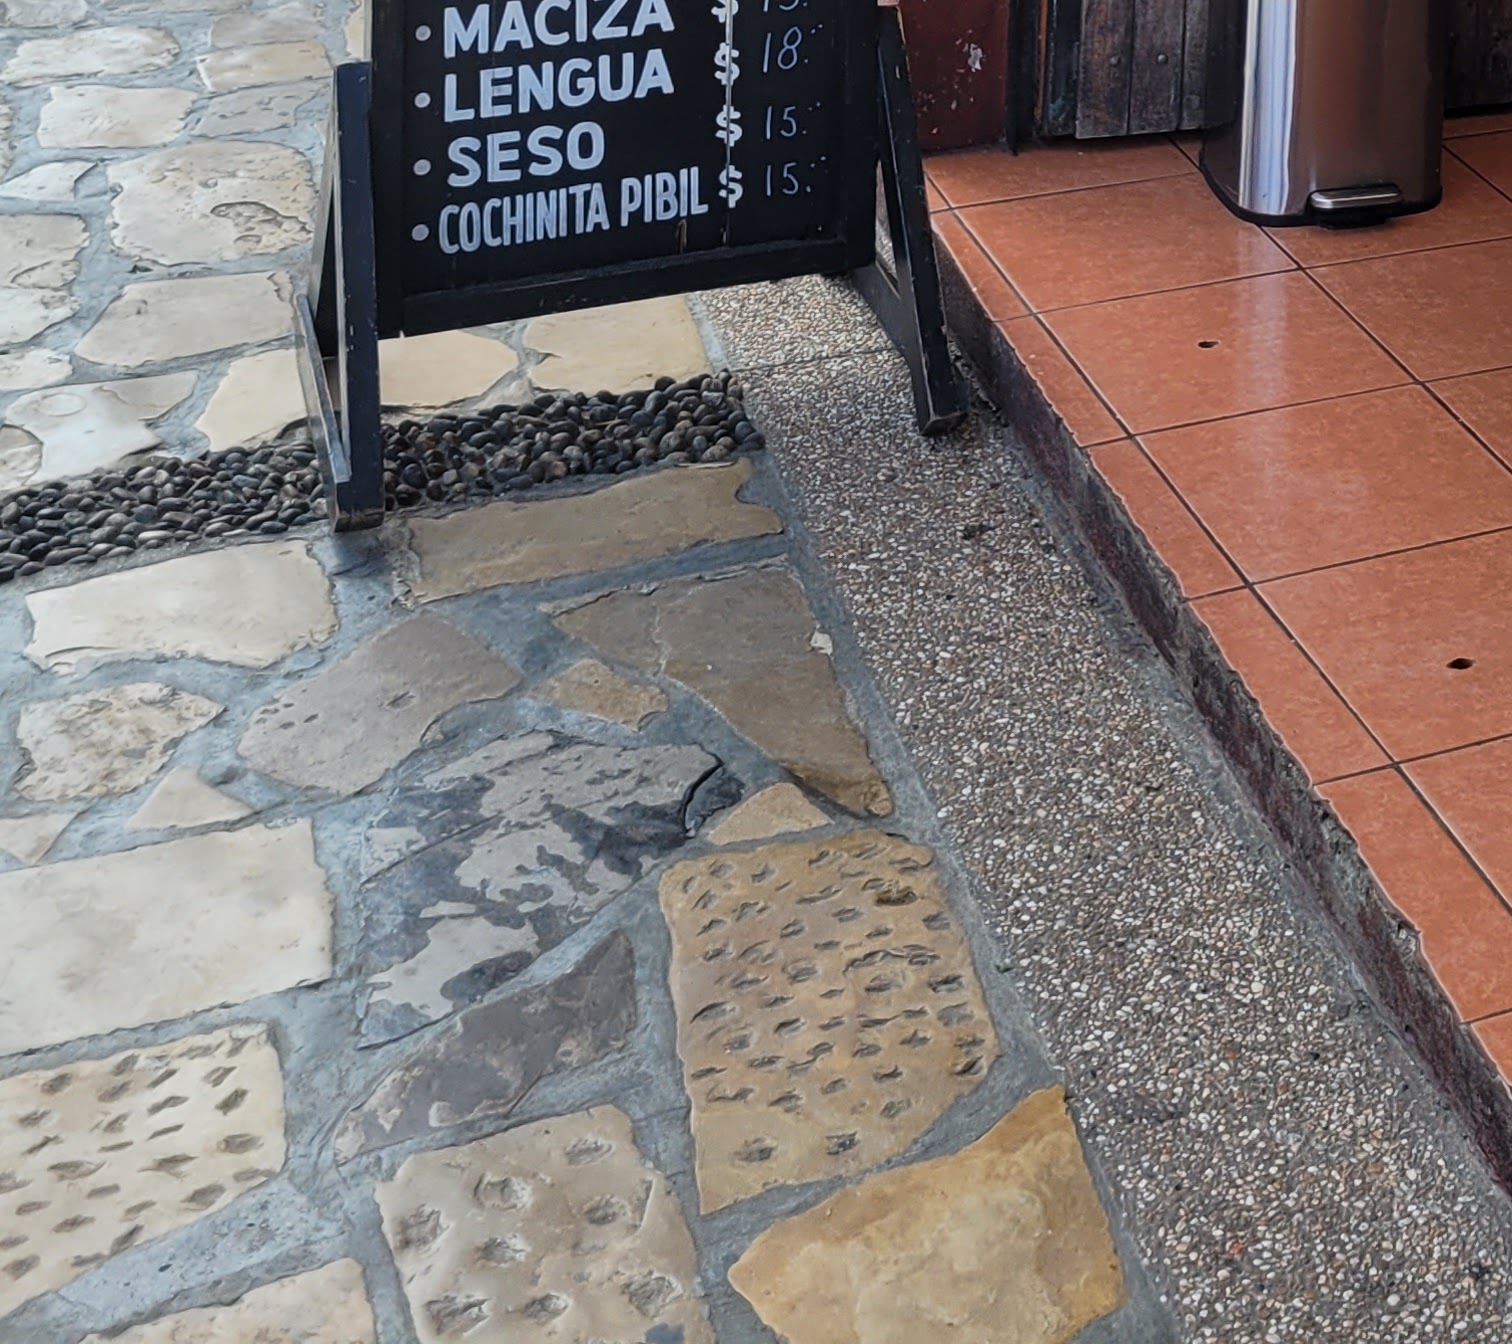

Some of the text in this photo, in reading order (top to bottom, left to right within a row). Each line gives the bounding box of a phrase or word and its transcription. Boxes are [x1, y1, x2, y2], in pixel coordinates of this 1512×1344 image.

[443, 48, 675, 123] LENGUA
[447, 121, 606, 188] SESO
[438, 182, 610, 254] COCHINITA
[620, 165, 709, 228] PIBIL
